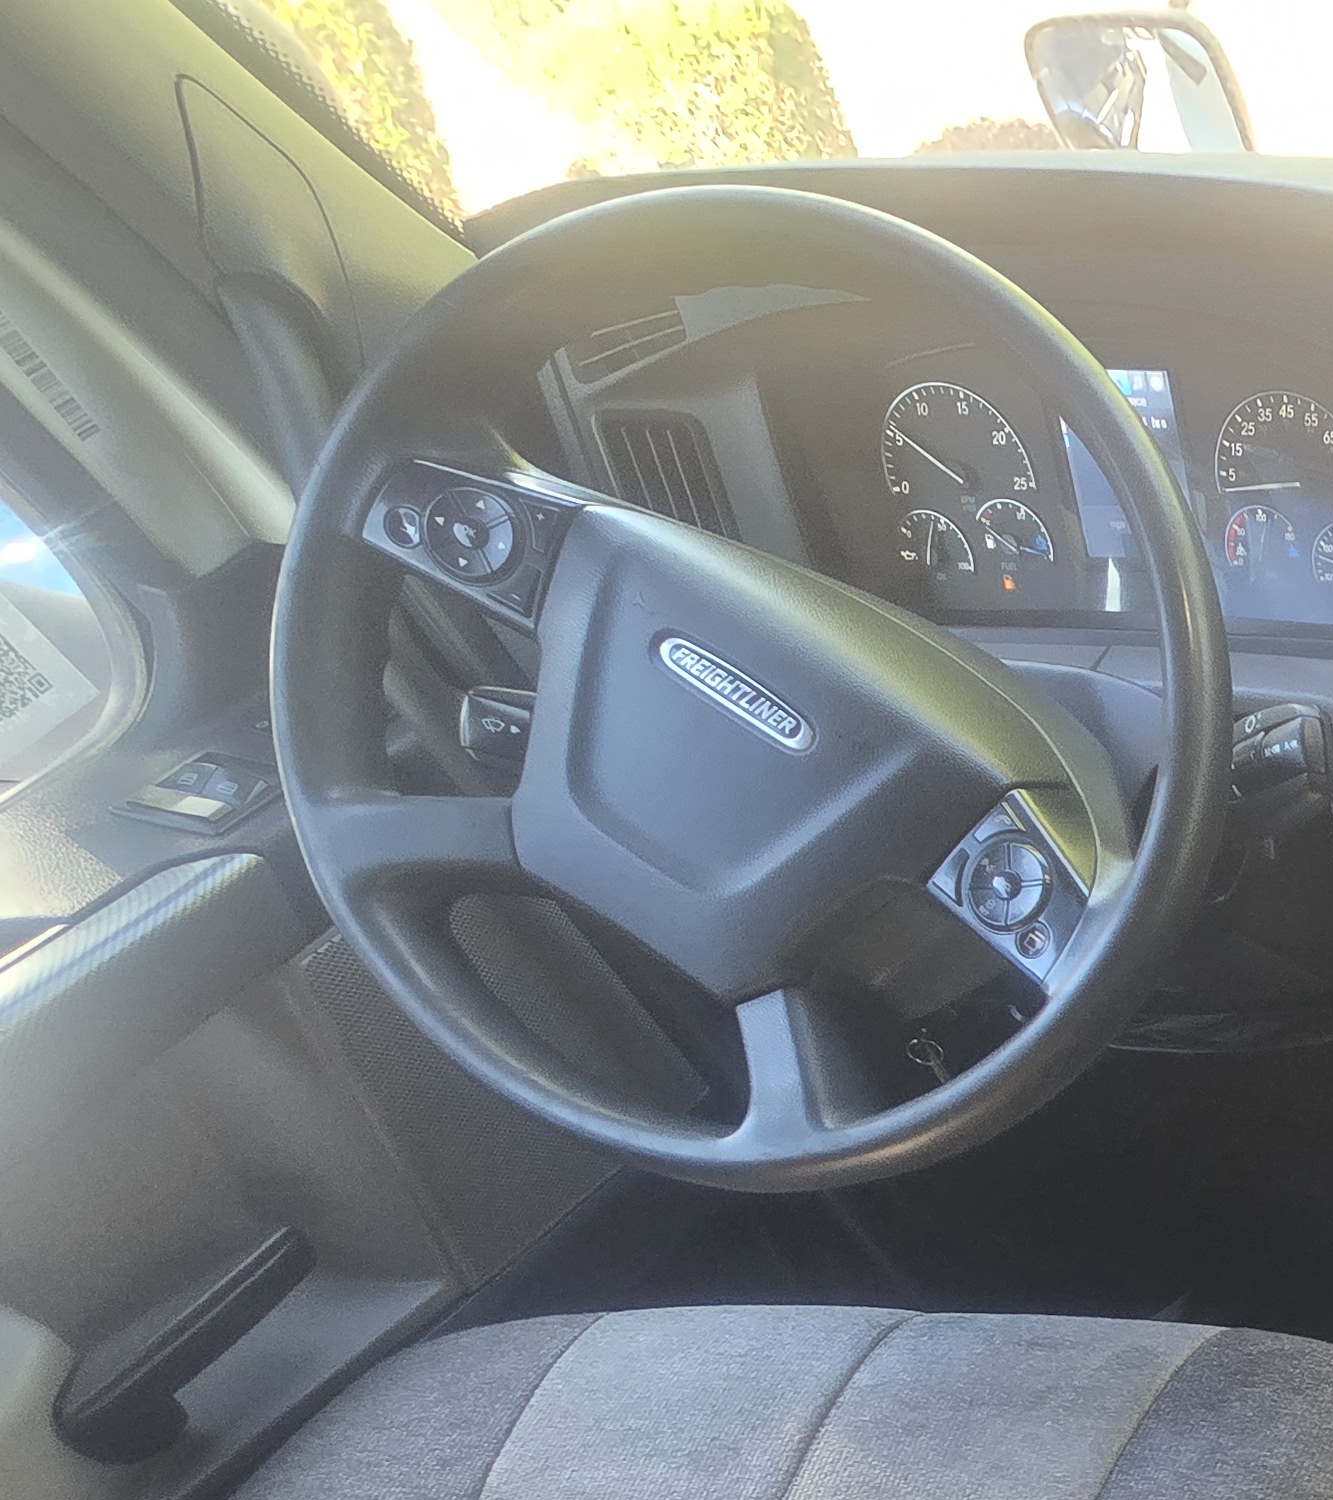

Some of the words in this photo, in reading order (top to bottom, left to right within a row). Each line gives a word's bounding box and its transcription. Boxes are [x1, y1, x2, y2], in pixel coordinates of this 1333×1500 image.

[916, 403, 929, 416] 10
[956, 402, 969, 415] 15
[1258, 408, 1272, 421] 35
[1279, 405, 1294, 418] 45
[1304, 413, 1318, 427] 55
[1241, 422, 1255, 436] 25
[895, 433, 903, 446] 5
[992, 431, 1006, 445] 20
[1231, 443, 1243, 456] 15
[1228, 468, 1236, 481] 5
[901, 481, 910, 494] 0
[1014, 477, 1028, 491] 25
[671, 647, 798, 735] FREIGHTLINER
